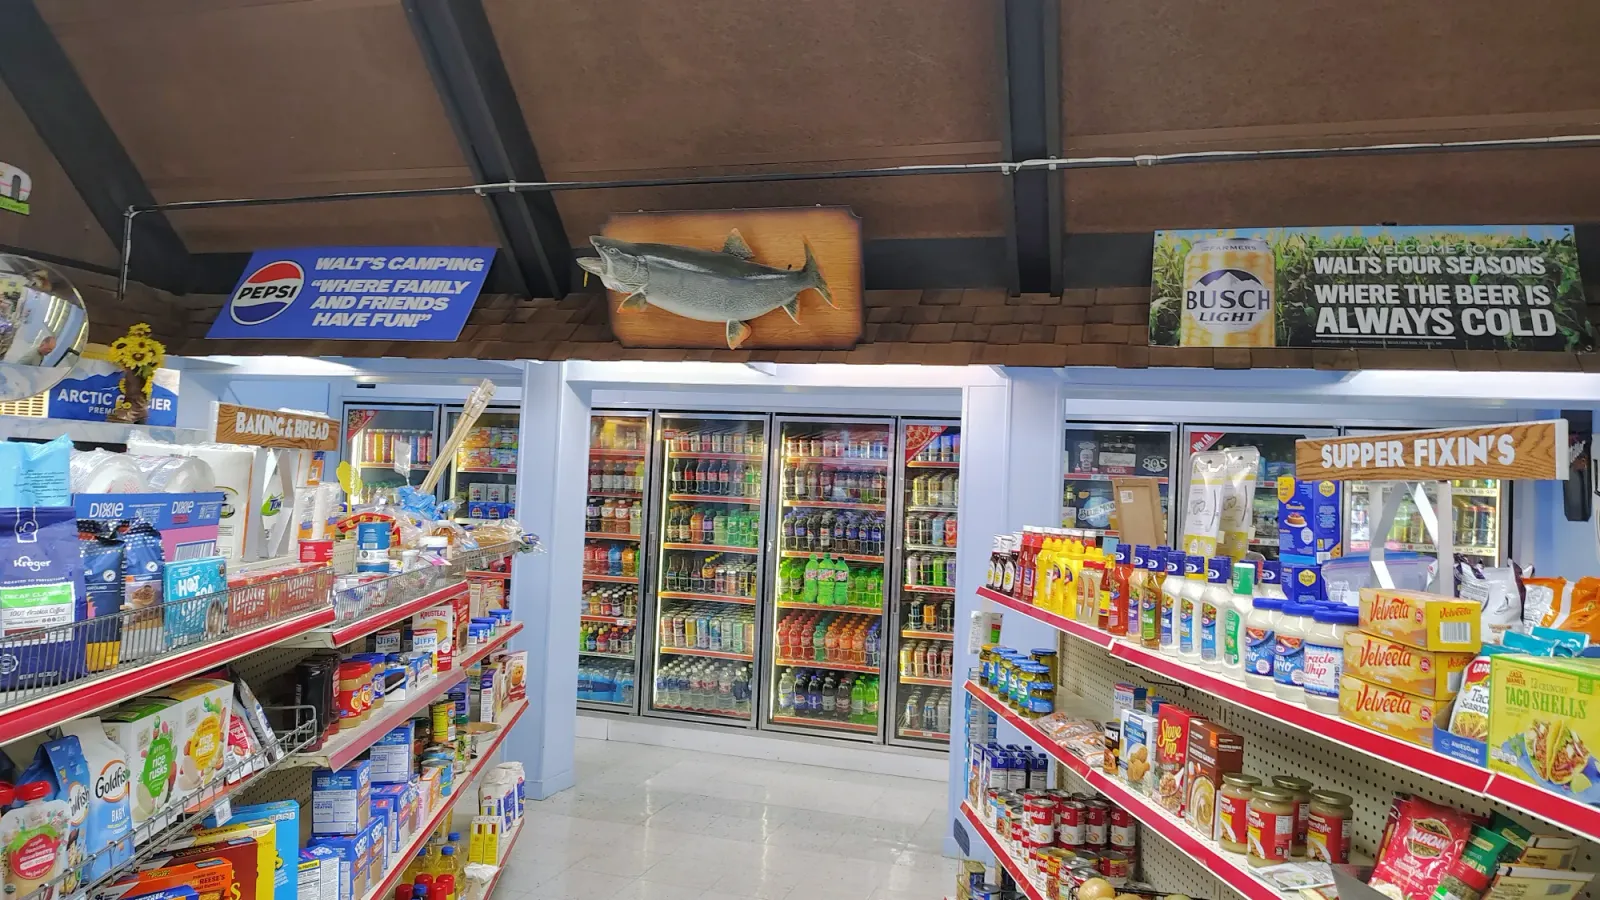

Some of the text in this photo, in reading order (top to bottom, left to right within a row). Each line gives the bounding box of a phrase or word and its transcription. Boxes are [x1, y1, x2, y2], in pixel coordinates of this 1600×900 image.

[1364, 243, 1487, 256] WELCOME TO
[315, 257, 484, 272] WALT'S CAMPING
[1313, 256, 1546, 276] WALTS FOUR SEASONS
[237, 284, 298, 301] PEPSI
[392, 279, 471, 294] FAMILY
[1186, 289, 1270, 311] BUSCH
[1314, 284, 1551, 306] WHERE THE BEER IS
[309, 296, 450, 311] AND FRIENDS
[310, 313, 370, 327] HAVE
[1198, 311, 1258, 323] LIGHT
[1316, 308, 1557, 337] ALWAYS COLD
[57, 388, 112, 406] ARCTIC
[235, 411, 330, 441] BAKING & BREAD
[1320, 434, 1516, 469] SUPPER FIXIN'S
[1106, 466, 1127, 474] LAGER
[1142, 457, 1168, 472] 805
[1079, 507, 1099, 520] BLUE
[1099, 502, 1116, 513] MOO
[13, 555, 52, 571] Kroger
[178, 575, 200, 597] HOT
[420, 610, 447, 620] KRUSTEAZ
[1370, 593, 1410, 623] Velveeta
[1440, 607, 1473, 619] Velveeta
[377, 636, 399, 645] JIFFY
[414, 636, 436, 646] JIFFY
[1305, 653, 1335, 664] racle
[1359, 640, 1412, 668] Velveeta
[1471, 688, 1488, 703] Tac
[1539, 683, 1569, 694] CRUNCHY
[1114, 693, 1133, 703] JIFFY
[1356, 684, 1411, 715] Velveeta
[1505, 686, 1588, 720] TACO SHELLS
[1158, 719, 1182, 747] Stove
[199, 734, 213, 748] rice
[1451, 741, 1480, 755] AWESOME
[1164, 740, 1178, 758] Top
[152, 754, 166, 769] rice
[1451, 751, 1480, 764] AFFORDABLE
[148, 765, 168, 780] rusks
[95, 766, 127, 799] Goldfis
[111, 805, 125, 823] BABY
[175, 846, 216, 858] Cheerios
[199, 874, 226, 885] REESE'S
